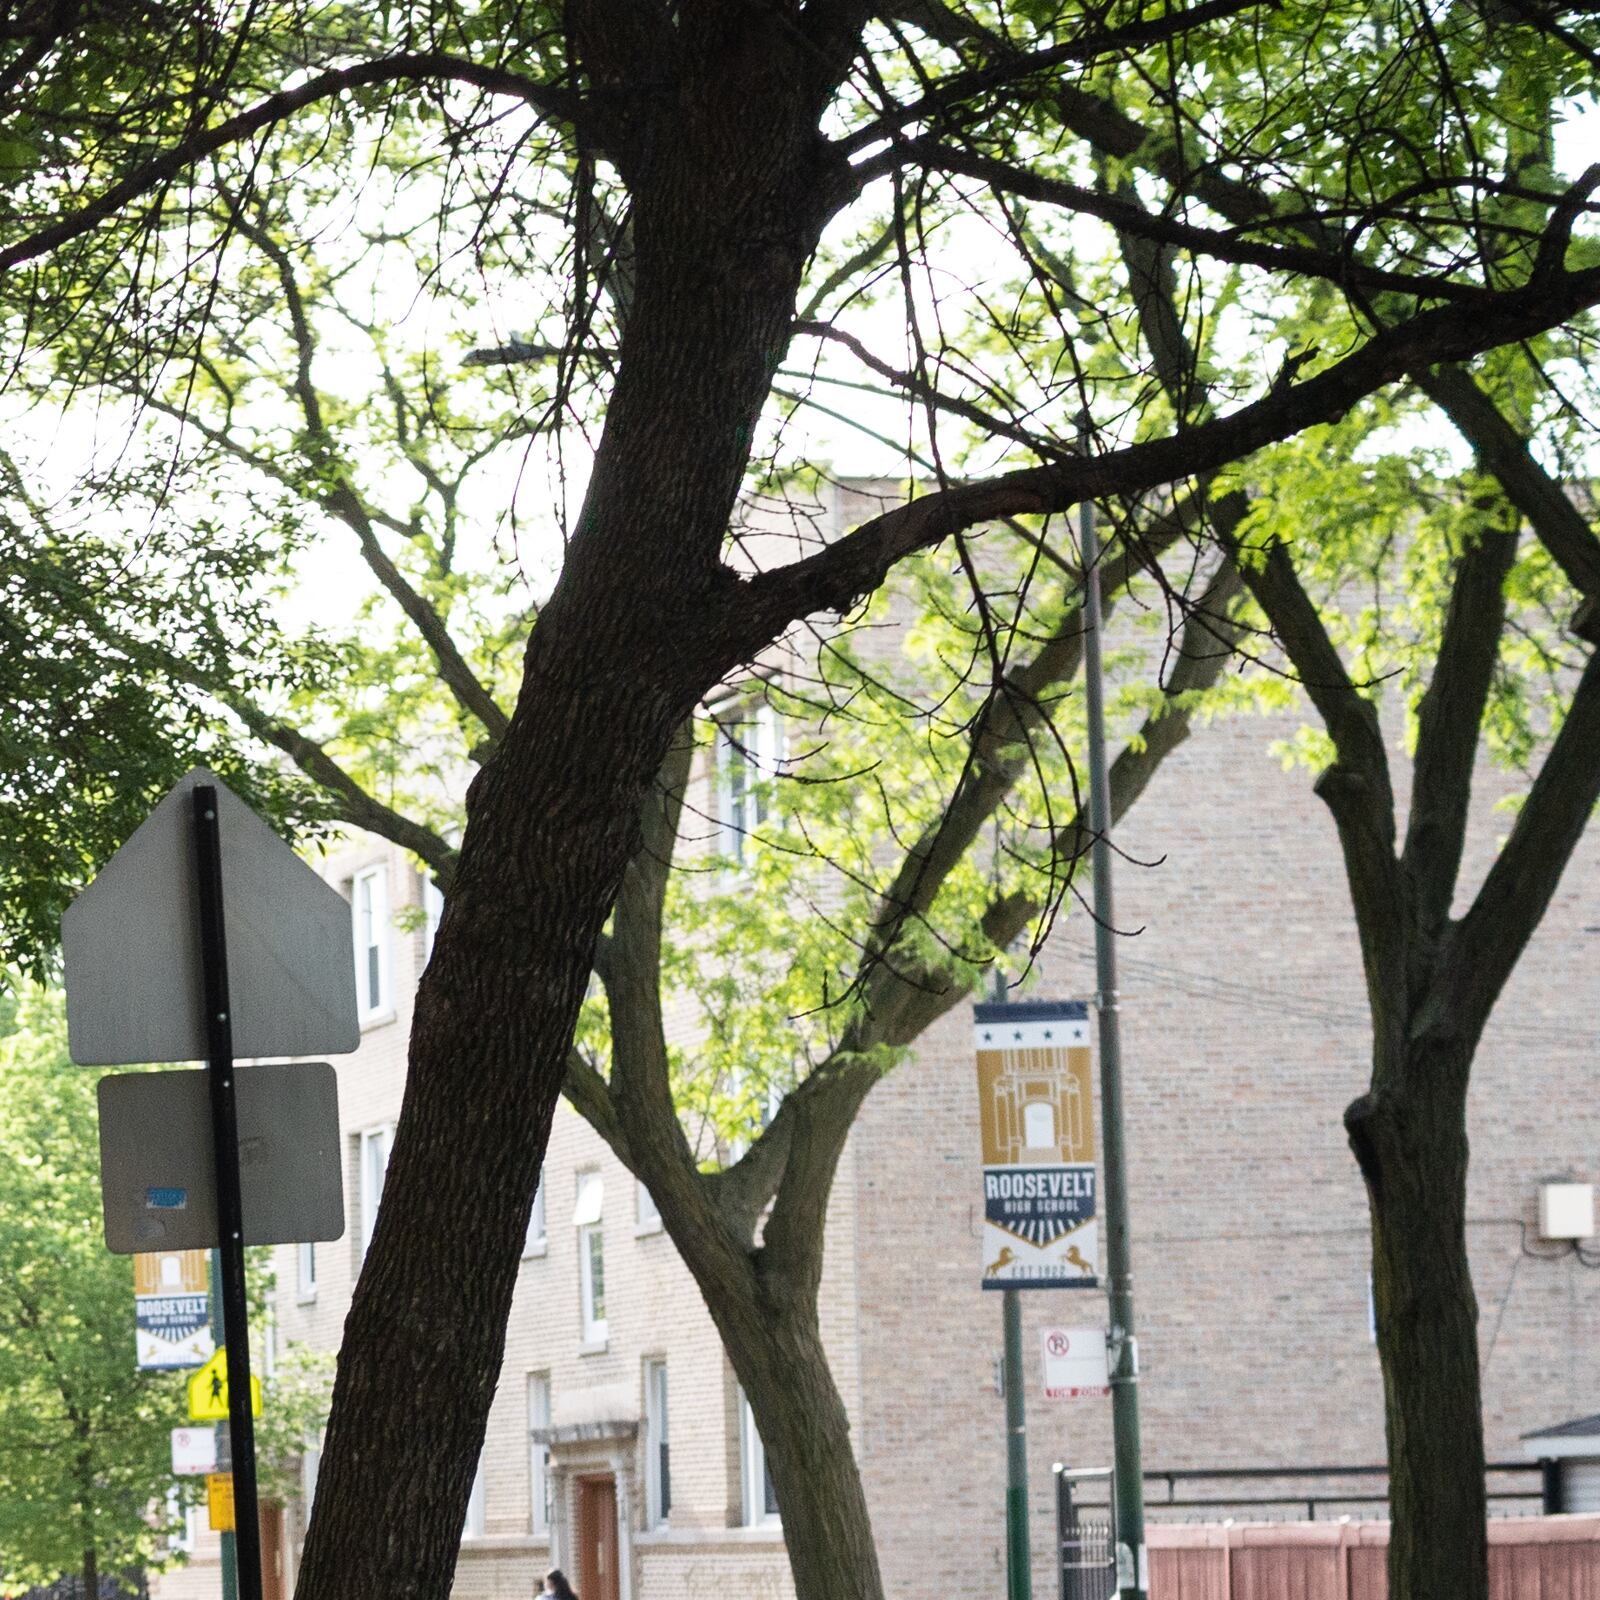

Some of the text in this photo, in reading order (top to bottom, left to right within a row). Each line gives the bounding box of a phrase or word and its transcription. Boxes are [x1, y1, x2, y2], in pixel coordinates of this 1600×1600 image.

[985, 1171, 1094, 1199] ROOSEVELT
[1004, 1199, 1080, 1214] HIGH SCHOOL
[136, 1297, 207, 1317] ROOSEVELT
